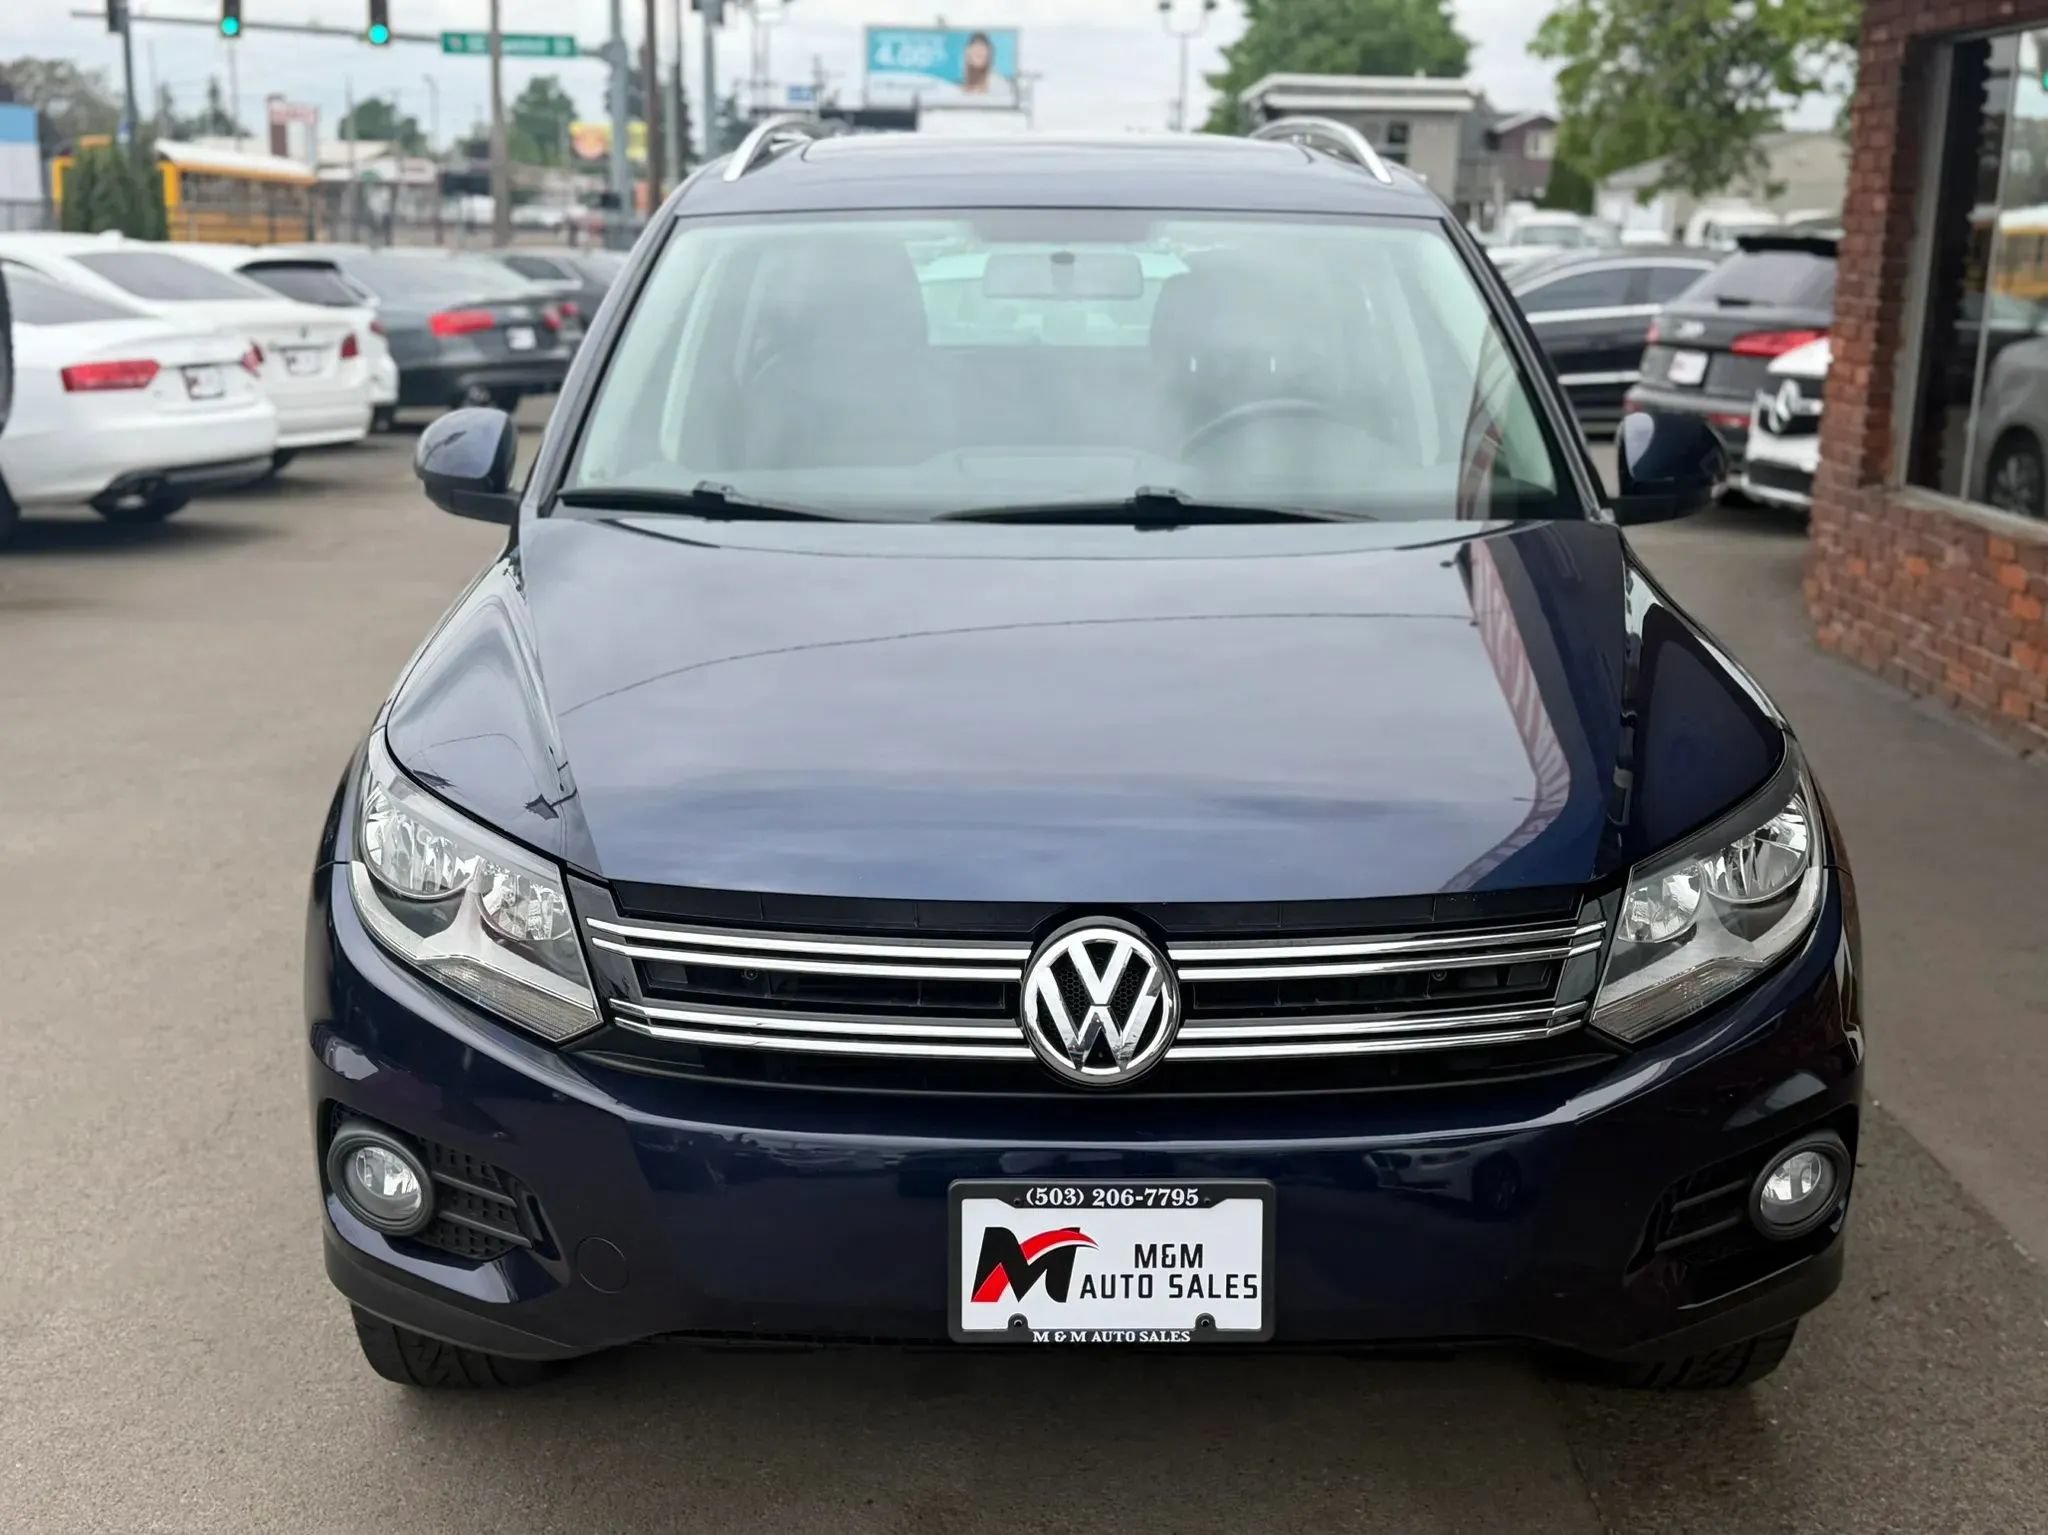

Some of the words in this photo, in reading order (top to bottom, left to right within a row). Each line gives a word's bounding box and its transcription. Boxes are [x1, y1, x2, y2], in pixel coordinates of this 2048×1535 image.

[1026, 1187, 1085, 1206] (503)
[1092, 1187, 1200, 1207] 206-7795
[1133, 1243, 1204, 1269] M&M
[1079, 1274, 1154, 1300] AUTO
[1168, 1273, 1259, 1300] SALES
[1032, 1330, 1050, 1343] M
[1054, 1330, 1067, 1343] &
[1070, 1330, 1087, 1343] M
[1091, 1330, 1136, 1343] AUTO
[1139, 1330, 1191, 1343] SALES
